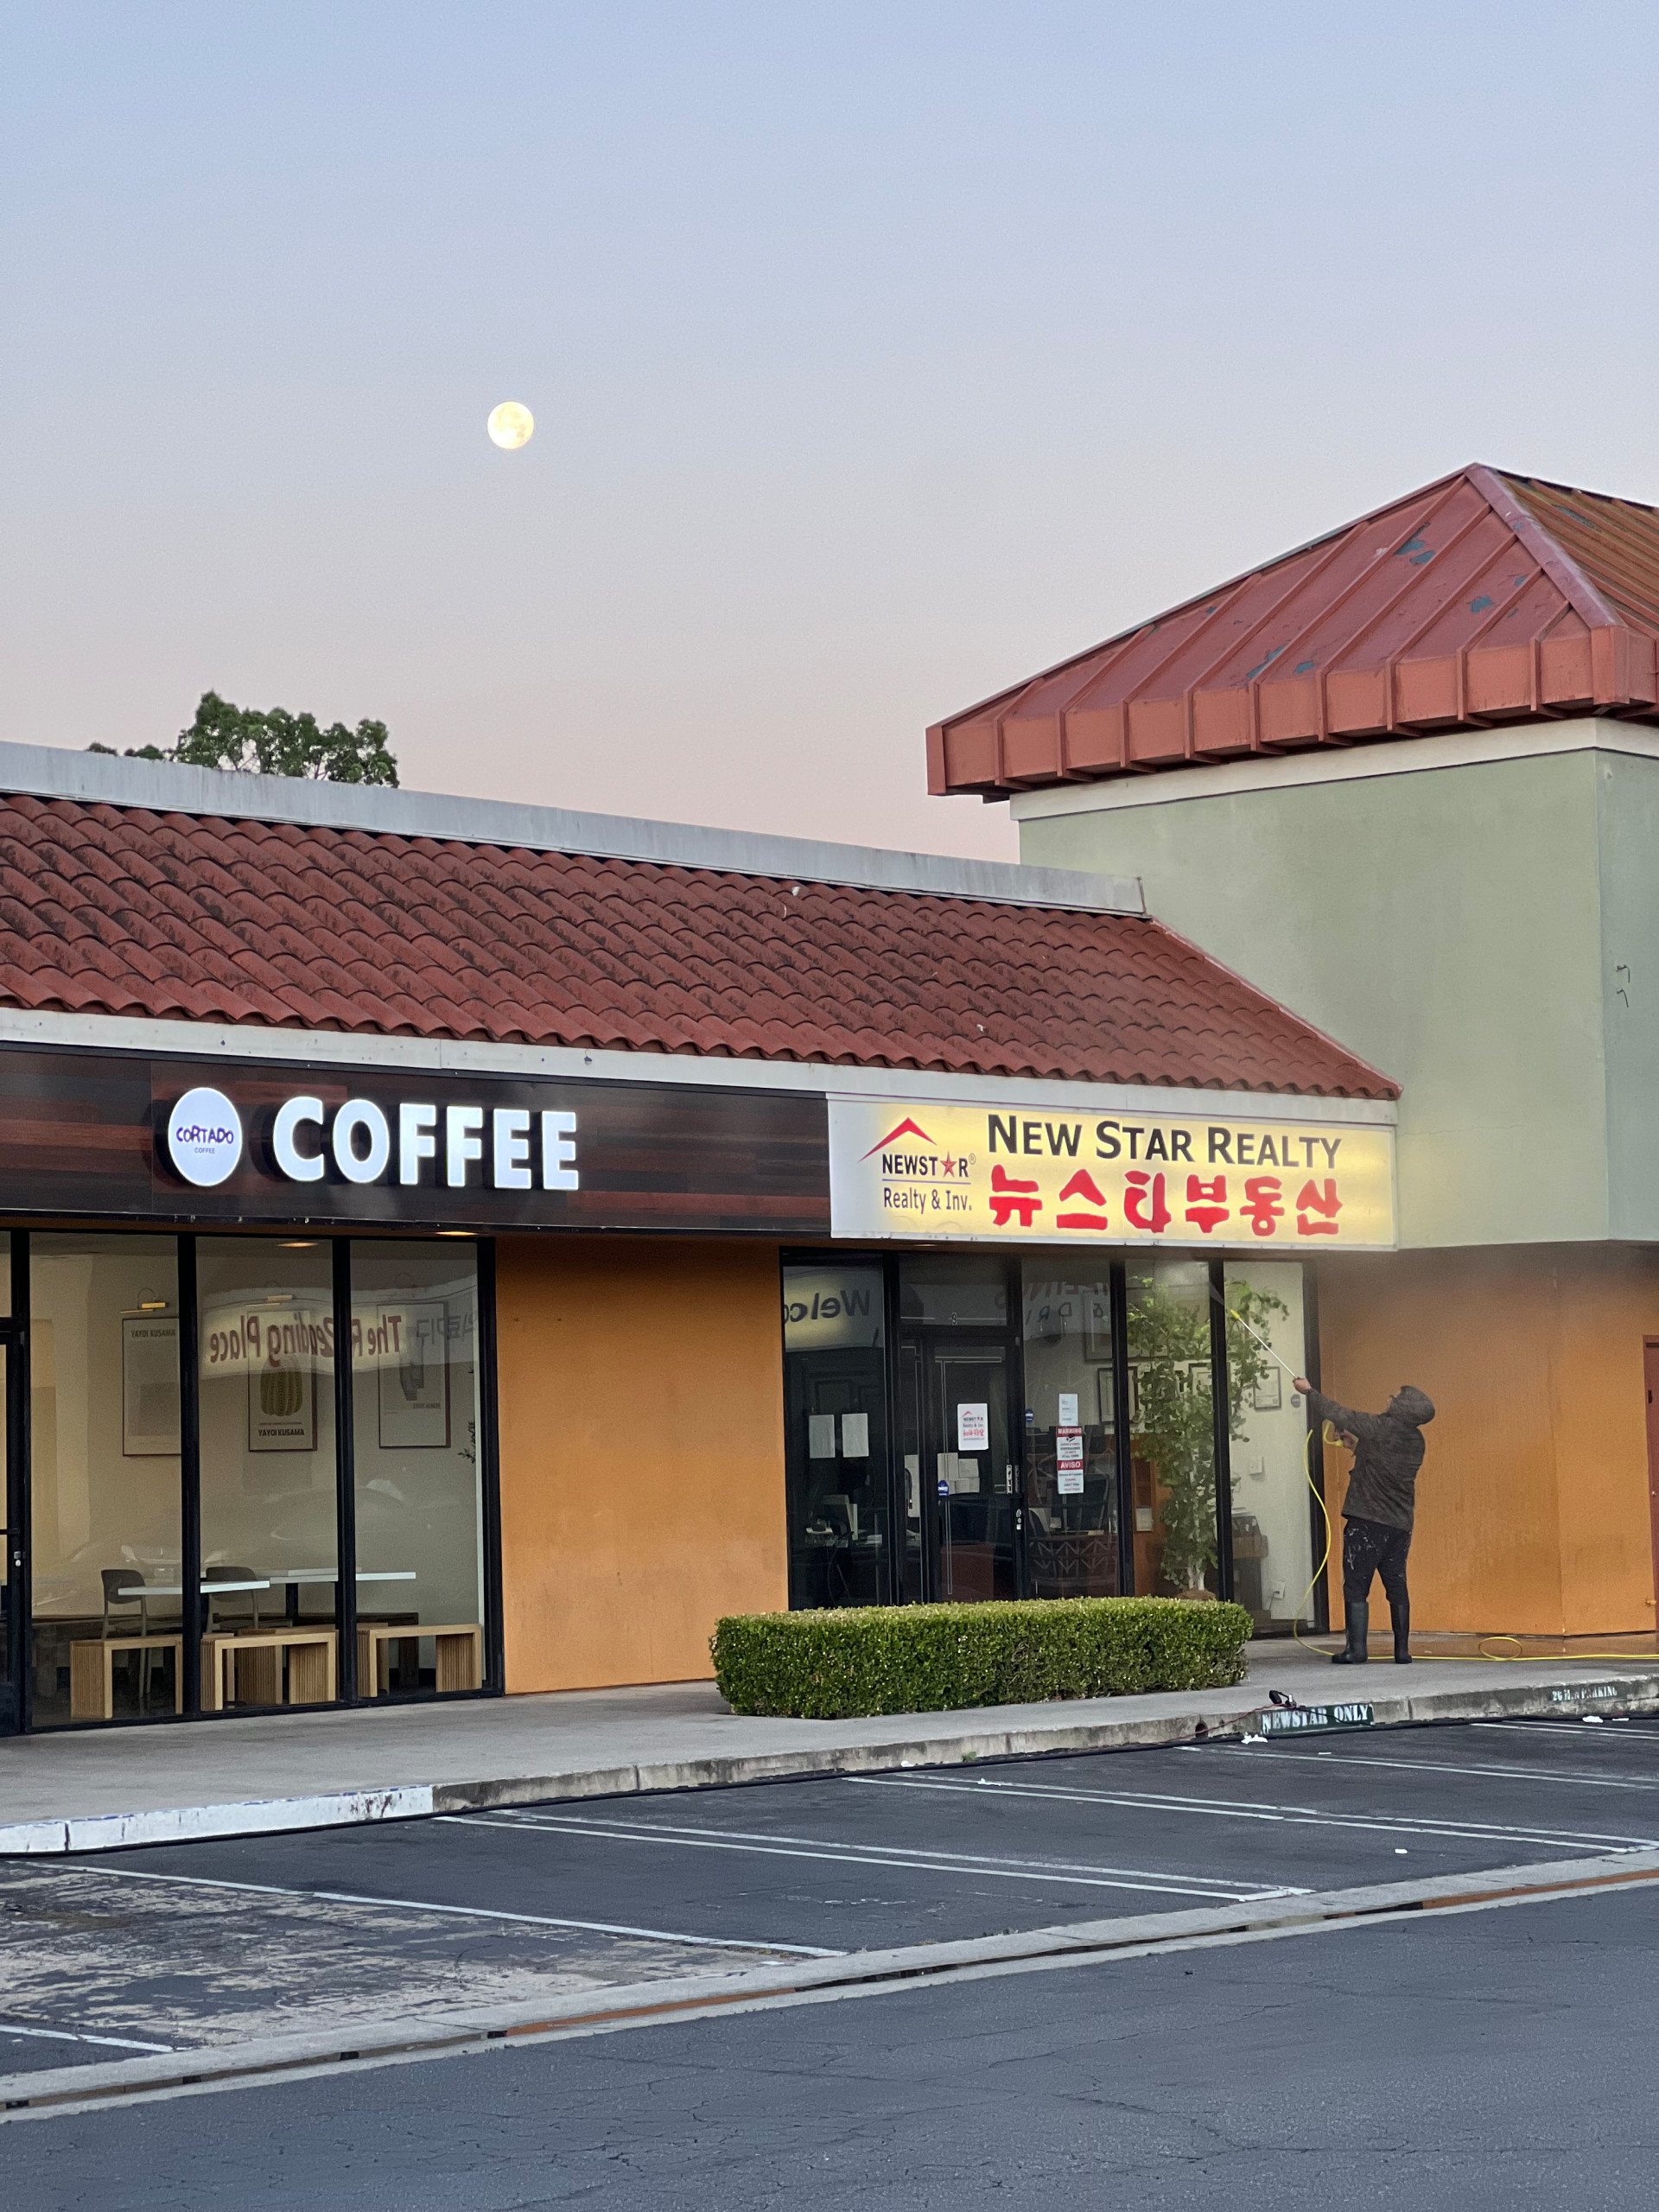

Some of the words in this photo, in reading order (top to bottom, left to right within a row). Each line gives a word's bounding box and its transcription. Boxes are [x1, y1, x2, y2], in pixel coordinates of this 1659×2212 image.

[175, 1124, 234, 1144] CORTADO
[272, 1096, 580, 1191] COFFEE
[988, 1114, 1083, 1157] NEW
[1096, 1120, 1196, 1162] STAR
[1207, 1126, 1343, 1169] REALTY
[883, 1186, 926, 1215] Realty
[931, 1188, 942, 1210] &
[945, 1190, 972, 1211] Inv.
[988, 1164, 1344, 1236] 뉴스타부동산
[1262, 1707, 1328, 1735] NEWSTAR
[1334, 1703, 1369, 1723] ONLY
